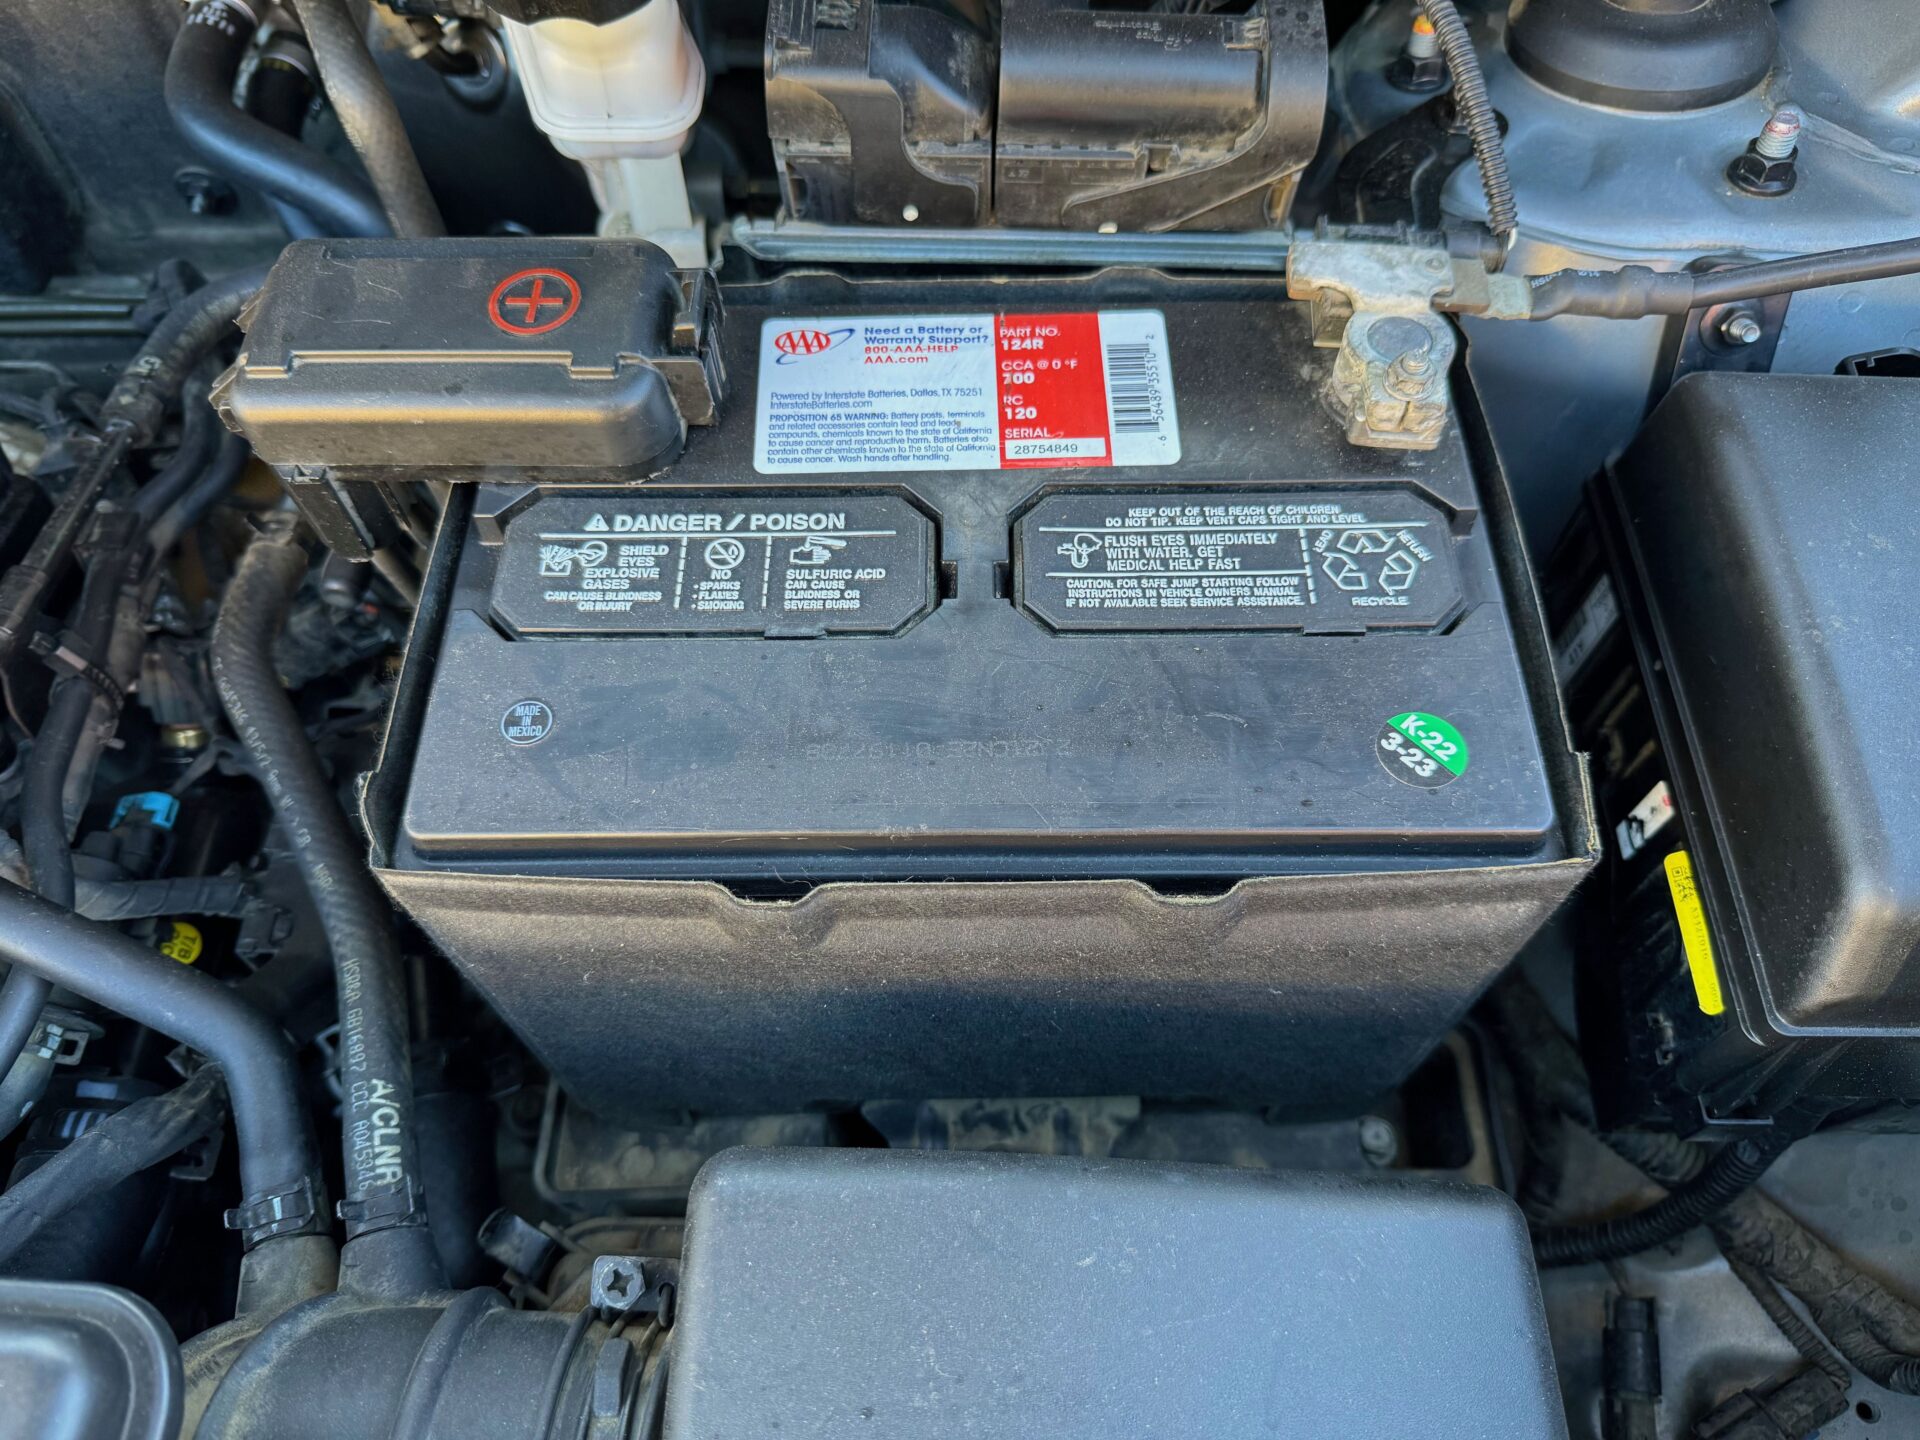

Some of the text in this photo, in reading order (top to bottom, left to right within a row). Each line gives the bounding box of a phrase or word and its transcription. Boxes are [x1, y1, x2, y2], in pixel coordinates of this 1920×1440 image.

[864, 327, 900, 335] Need
[918, 326, 964, 336] Battery
[1000, 327, 1061, 337] PART NO.
[778, 330, 829, 354] AAA
[864, 335, 989, 346] Warranty Support?
[1001, 339, 1044, 350] 124R
[864, 345, 958, 354] 800-AAA-HELP
[864, 355, 928, 364] AAA.com
[1001, 360, 1034, 371] CCA
[1052, 360, 1061, 370] 0
[1003, 372, 1035, 384] 700
[770, 388, 982, 401] Powered by Interstate Batteries, Dallas, TX 75251
[1003, 395, 1024, 405] RC
[770, 400, 873, 409] InterstateBatteries.com
[769, 414, 828, 422] PROPOSITION
[844, 412, 889, 420] WARNING:
[891, 412, 919, 421] Battery
[921, 411, 944, 420] posts,
[947, 410, 985, 418] terminals
[1004, 408, 1037, 420] 120
[787, 422, 816, 430] related
[817, 421, 866, 429] accessories
[768, 431, 820, 440] compounds,
[822, 430, 864, 438] chemicals
[943, 427, 951, 435] of
[953, 427, 992, 435] California
[1004, 428, 1051, 438] SERIAL
[768, 439, 776, 447] to
[854, 437, 905, 446] reproductive
[801, 447, 823, 455] other
[825, 446, 867, 454] chemicals
[924, 444, 944, 452] state
[956, 443, 996, 451] California
[1014, 444, 1078, 455] 28754849
[864, 454, 890, 462] hands
[912, 453, 951, 462] handling.
[1128, 505, 1340, 517] KEEP OUT OF THE REACH OF CHILDREN
[613, 514, 722, 532] DANGER
[750, 513, 846, 531] POISON
[1106, 514, 1366, 527] DO NOT TIP. KEEP VENT CAPS TIGHT AND LEVEL
[1104, 533, 1278, 547] FLUSH EYES IMMEDIATELY
[1312, 530, 1333, 553] LEAD
[1397, 529, 1434, 562] RETURN
[619, 545, 669, 556] SHIELD
[1106, 546, 1224, 559] WITH WATER. GET
[618, 557, 655, 567] EYES
[1107, 558, 1241, 571] MEDICAL HELP FAST
[584, 568, 660, 579] EXPLOSIVE
[711, 570, 732, 580] NO
[786, 568, 886, 580] SULFURIC ACID
[582, 579, 630, 590] GASES
[700, 582, 741, 590] SPARKS
[785, 580, 845, 590] CAN CAUSE
[1066, 576, 1299, 589] CAUTION: FOR SAFE JUMP STARTING FOLLOW
[544, 591, 662, 601] CAN CAUSE BLINDNESS
[784, 590, 860, 599] BLINDNESS OR
[1068, 589, 1143, 598] INSTRUCTIONS
[1146, 589, 1157, 598] IN
[1159, 588, 1203, 598] VEHICLE
[1205, 588, 1251, 597] OWNERS
[578, 602, 633, 611] OR INJURY
[784, 600, 860, 609] SEVERE BURNS
[1066, 596, 1305, 608] IF NOT AVAILABLE SEEK SERVICE ASSISTANCE.
[1351, 596, 1409, 606] RECYCLE
[515, 705, 542, 716] MADE
[522, 715, 532, 726] IN
[508, 725, 542, 737] MEXICO
[1400, 714, 1457, 762] K-22
[1380, 732, 1438, 777] 3-23
[370, 1078, 403, 1186] A/CLNR
